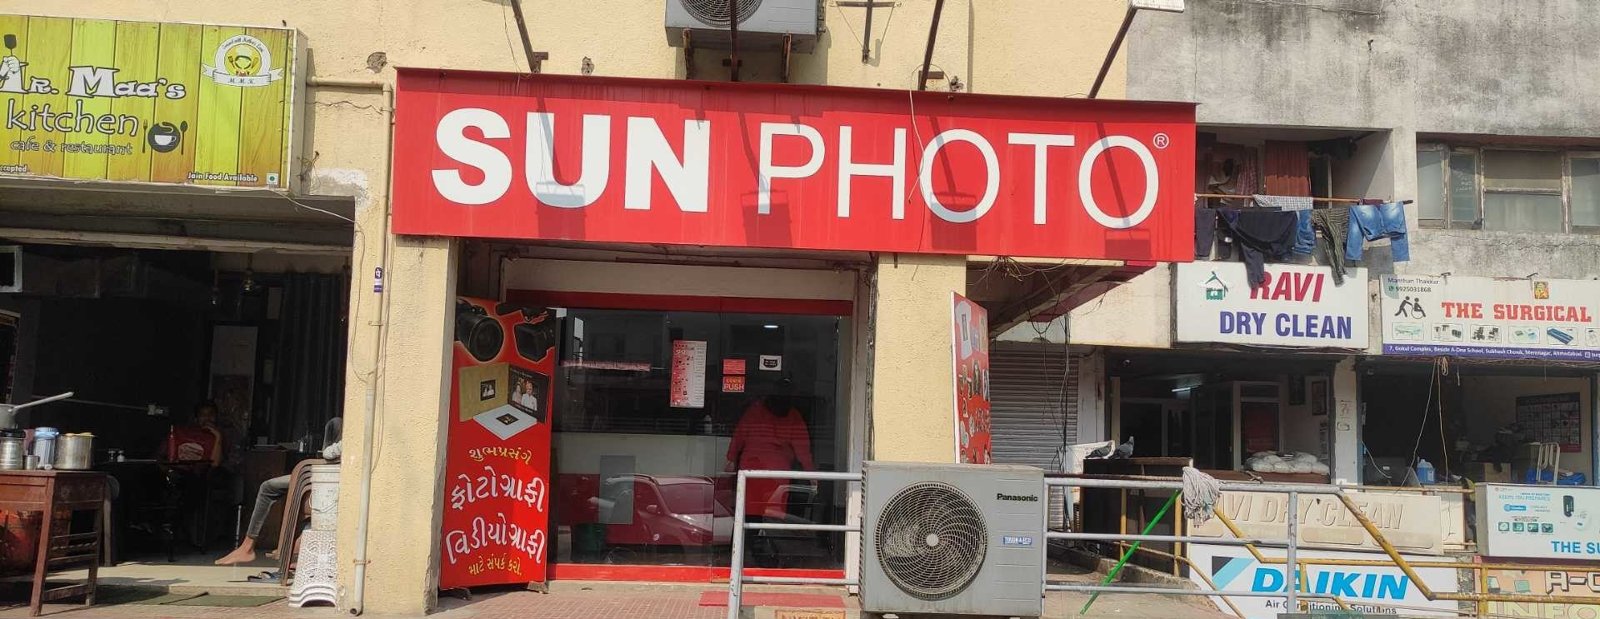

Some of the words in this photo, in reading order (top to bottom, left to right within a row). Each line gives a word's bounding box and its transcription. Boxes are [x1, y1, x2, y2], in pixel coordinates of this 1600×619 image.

[65, 65, 187, 99] Maa's
[6, 98, 140, 137] kitchen
[9, 135, 40, 152] cafe
[42, 139, 57, 153] &
[60, 140, 134, 155] restaurant
[187, 171, 204, 179] Jain
[205, 172, 222, 180] Food
[224, 173, 258, 182] Available
[431, 107, 711, 213] SUN
[757, 121, 1159, 230] PHOTO
[1249, 271, 1325, 302] RAVI
[1441, 302, 1483, 319] THE
[1493, 303, 1592, 322] SURGICAL
[1219, 311, 1267, 335] DRY
[1275, 313, 1352, 339] CLEAN
[723, 383, 745, 391] PUSH
[451, 465, 545, 513] ફોટોગ્રાફી
[996, 493, 1038, 502] Panasonic
[445, 512, 545, 565] વિડીયોગ્રાફી
[1550, 540, 1582, 553] THE
[1586, 542, 1600, 555] S
[1265, 600, 1280, 609] Air
